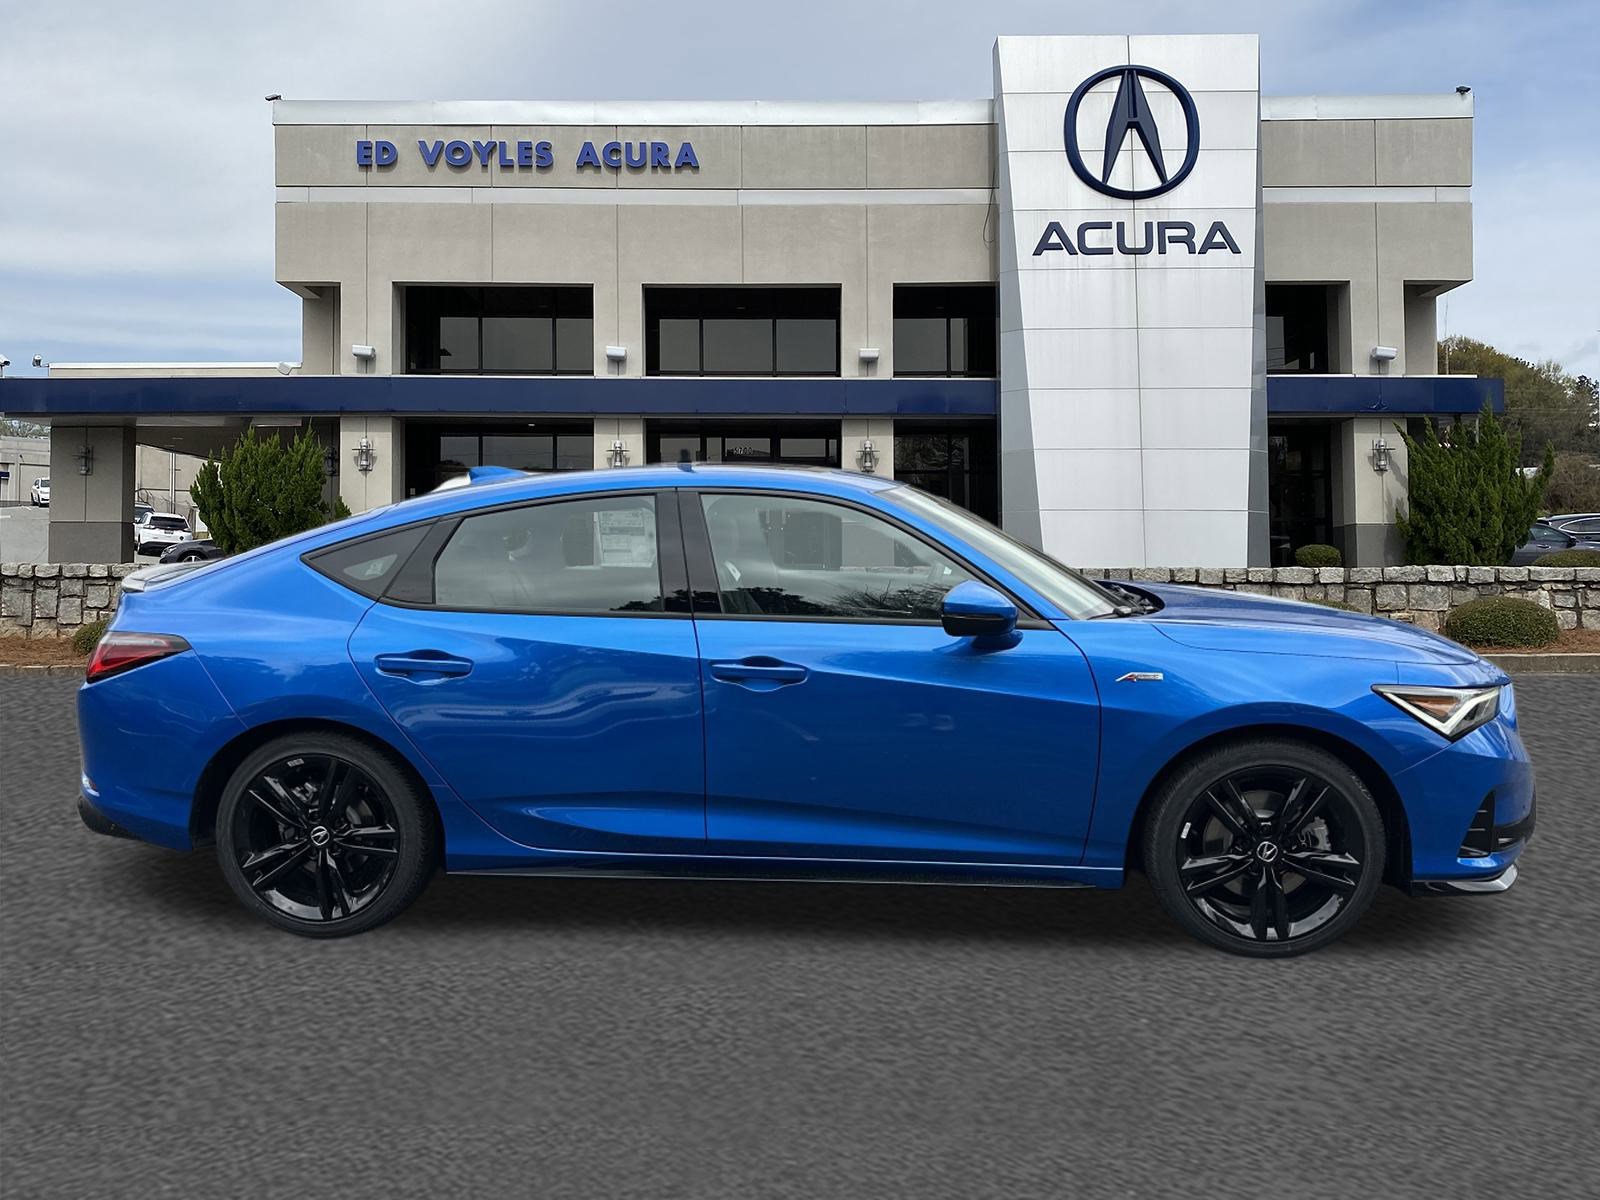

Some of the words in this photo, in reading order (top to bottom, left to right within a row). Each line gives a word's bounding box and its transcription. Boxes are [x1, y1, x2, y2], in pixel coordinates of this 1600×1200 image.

[356, 140, 398, 168] ED
[418, 140, 554, 168] VOYLES
[576, 141, 700, 168] ACURA
[1032, 221, 1242, 256] ACURA
